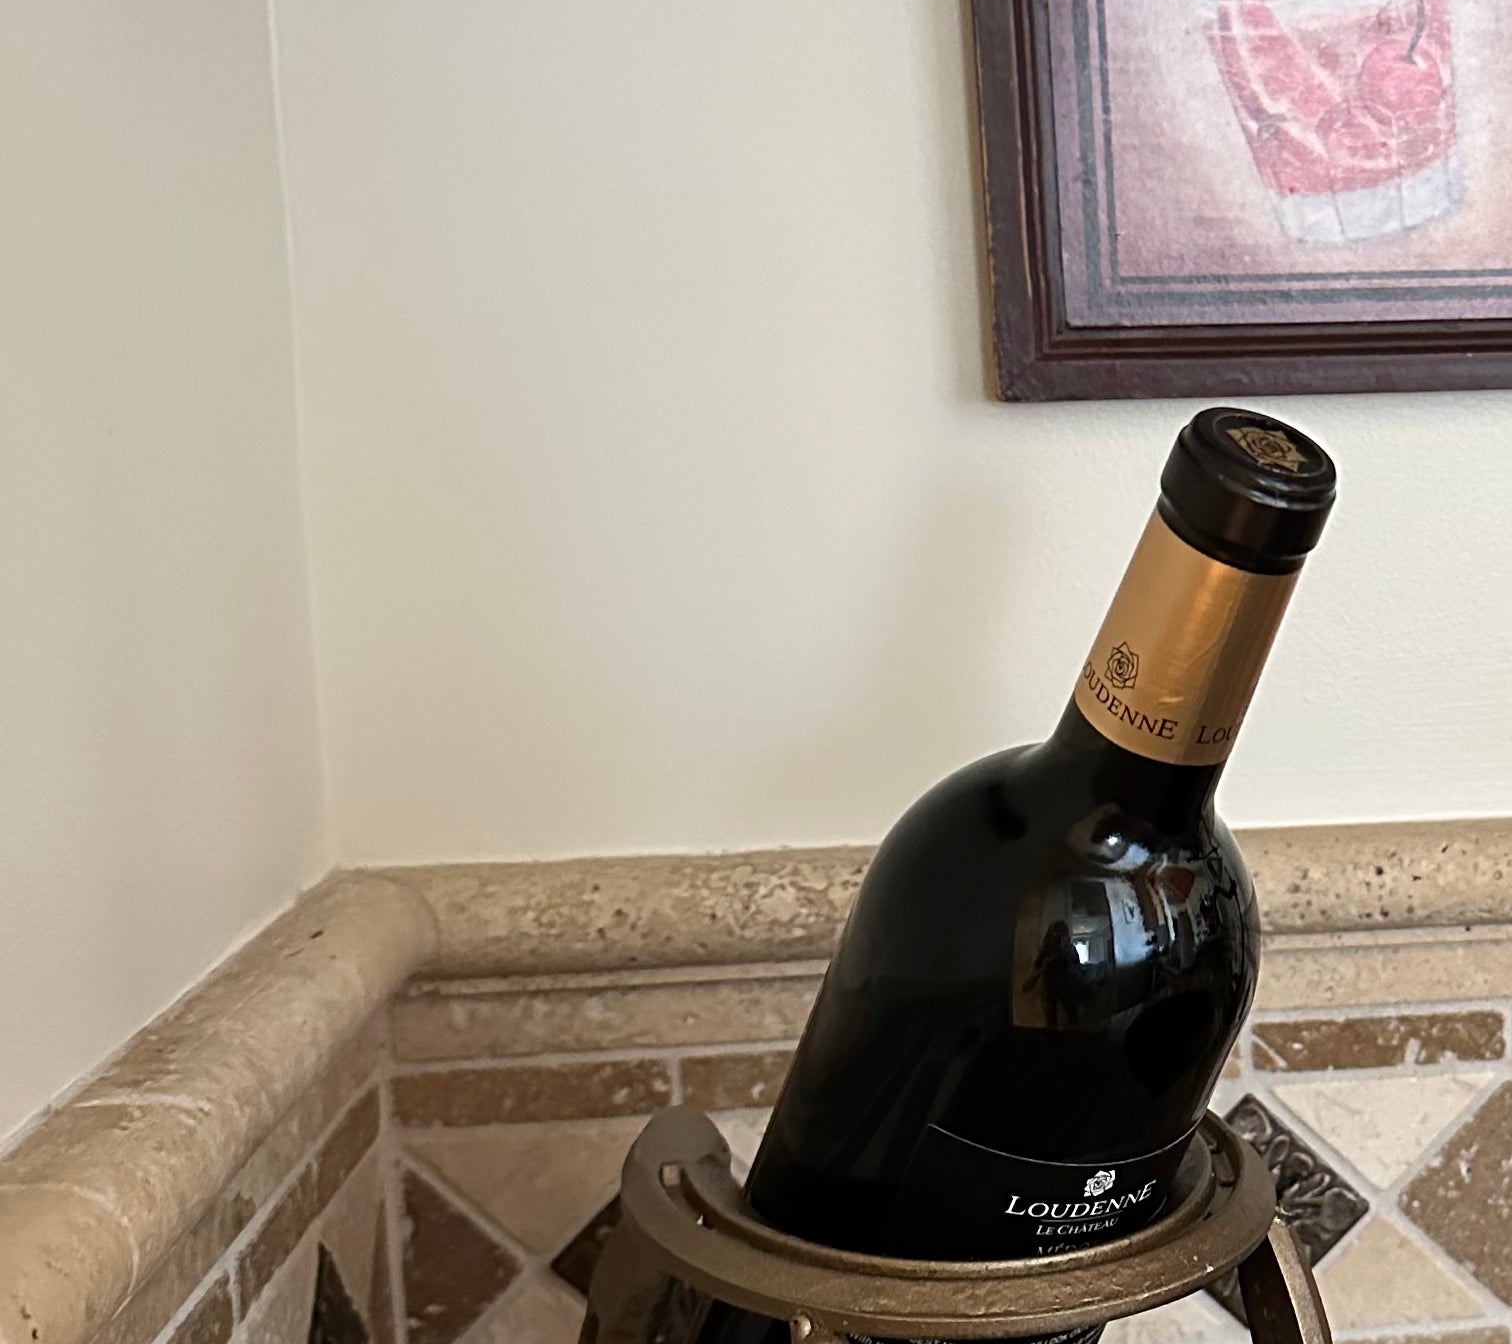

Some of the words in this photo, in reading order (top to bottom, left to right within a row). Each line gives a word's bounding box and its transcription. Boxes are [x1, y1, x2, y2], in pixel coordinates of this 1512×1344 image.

[1083, 660, 1178, 740] OUDENNE
[1004, 1179, 1156, 1219] LOUDENNE
[1036, 1224, 1055, 1236] LE
